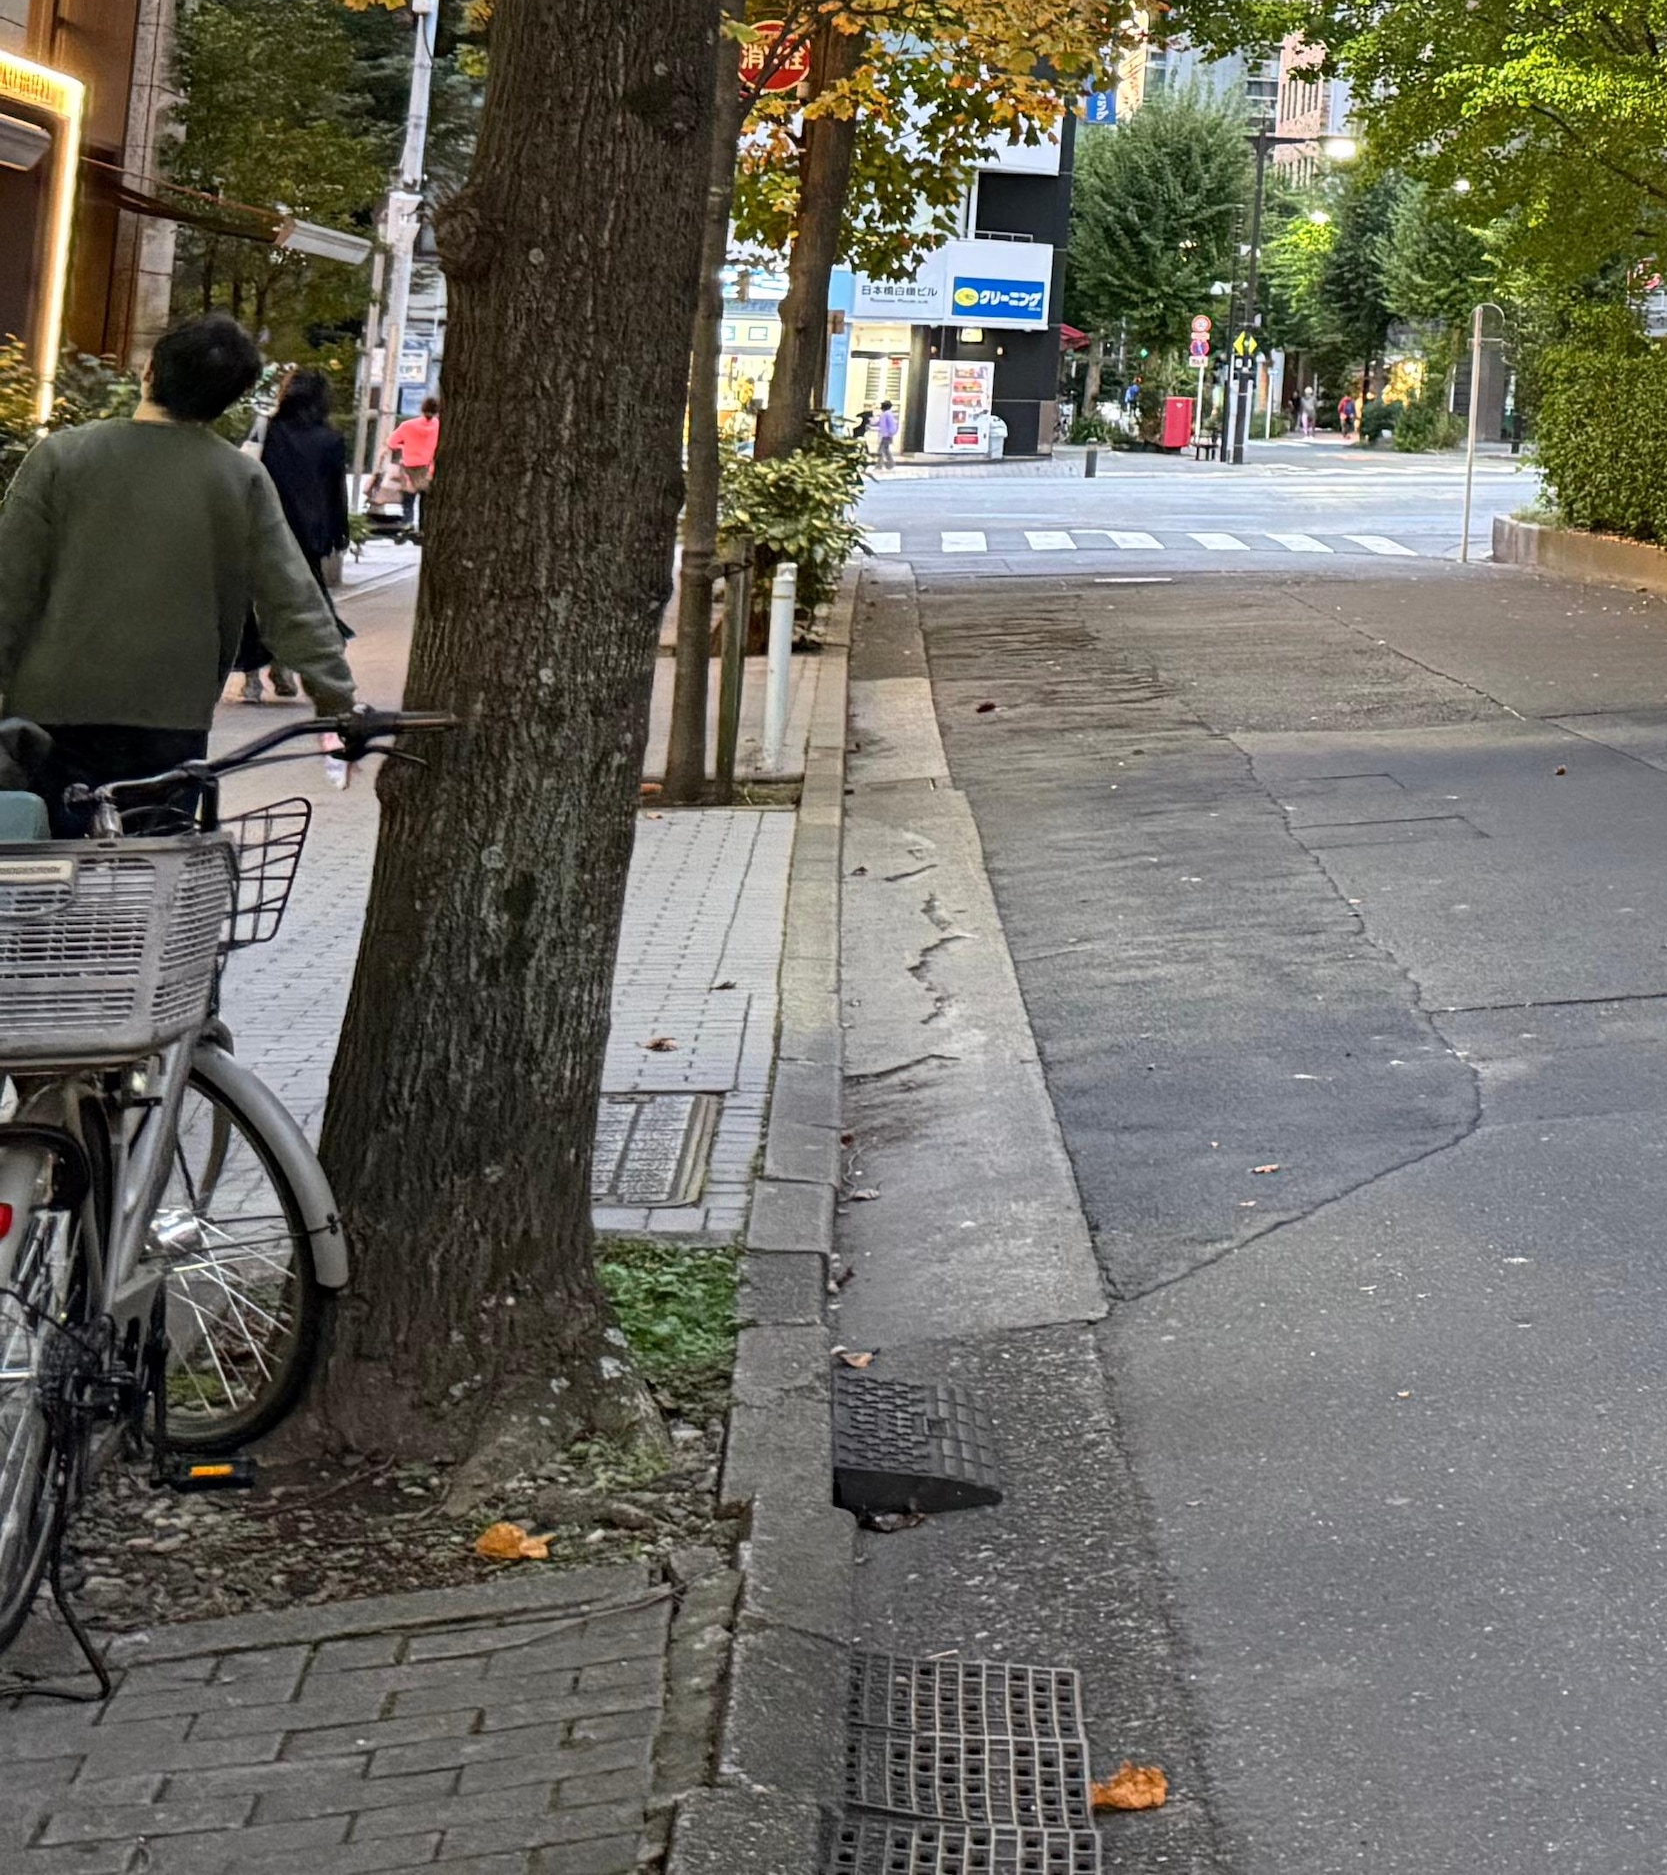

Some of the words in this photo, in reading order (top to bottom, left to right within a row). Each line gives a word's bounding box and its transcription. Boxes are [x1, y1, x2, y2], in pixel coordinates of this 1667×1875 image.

[979, 289, 1043, 307] クリーニング
